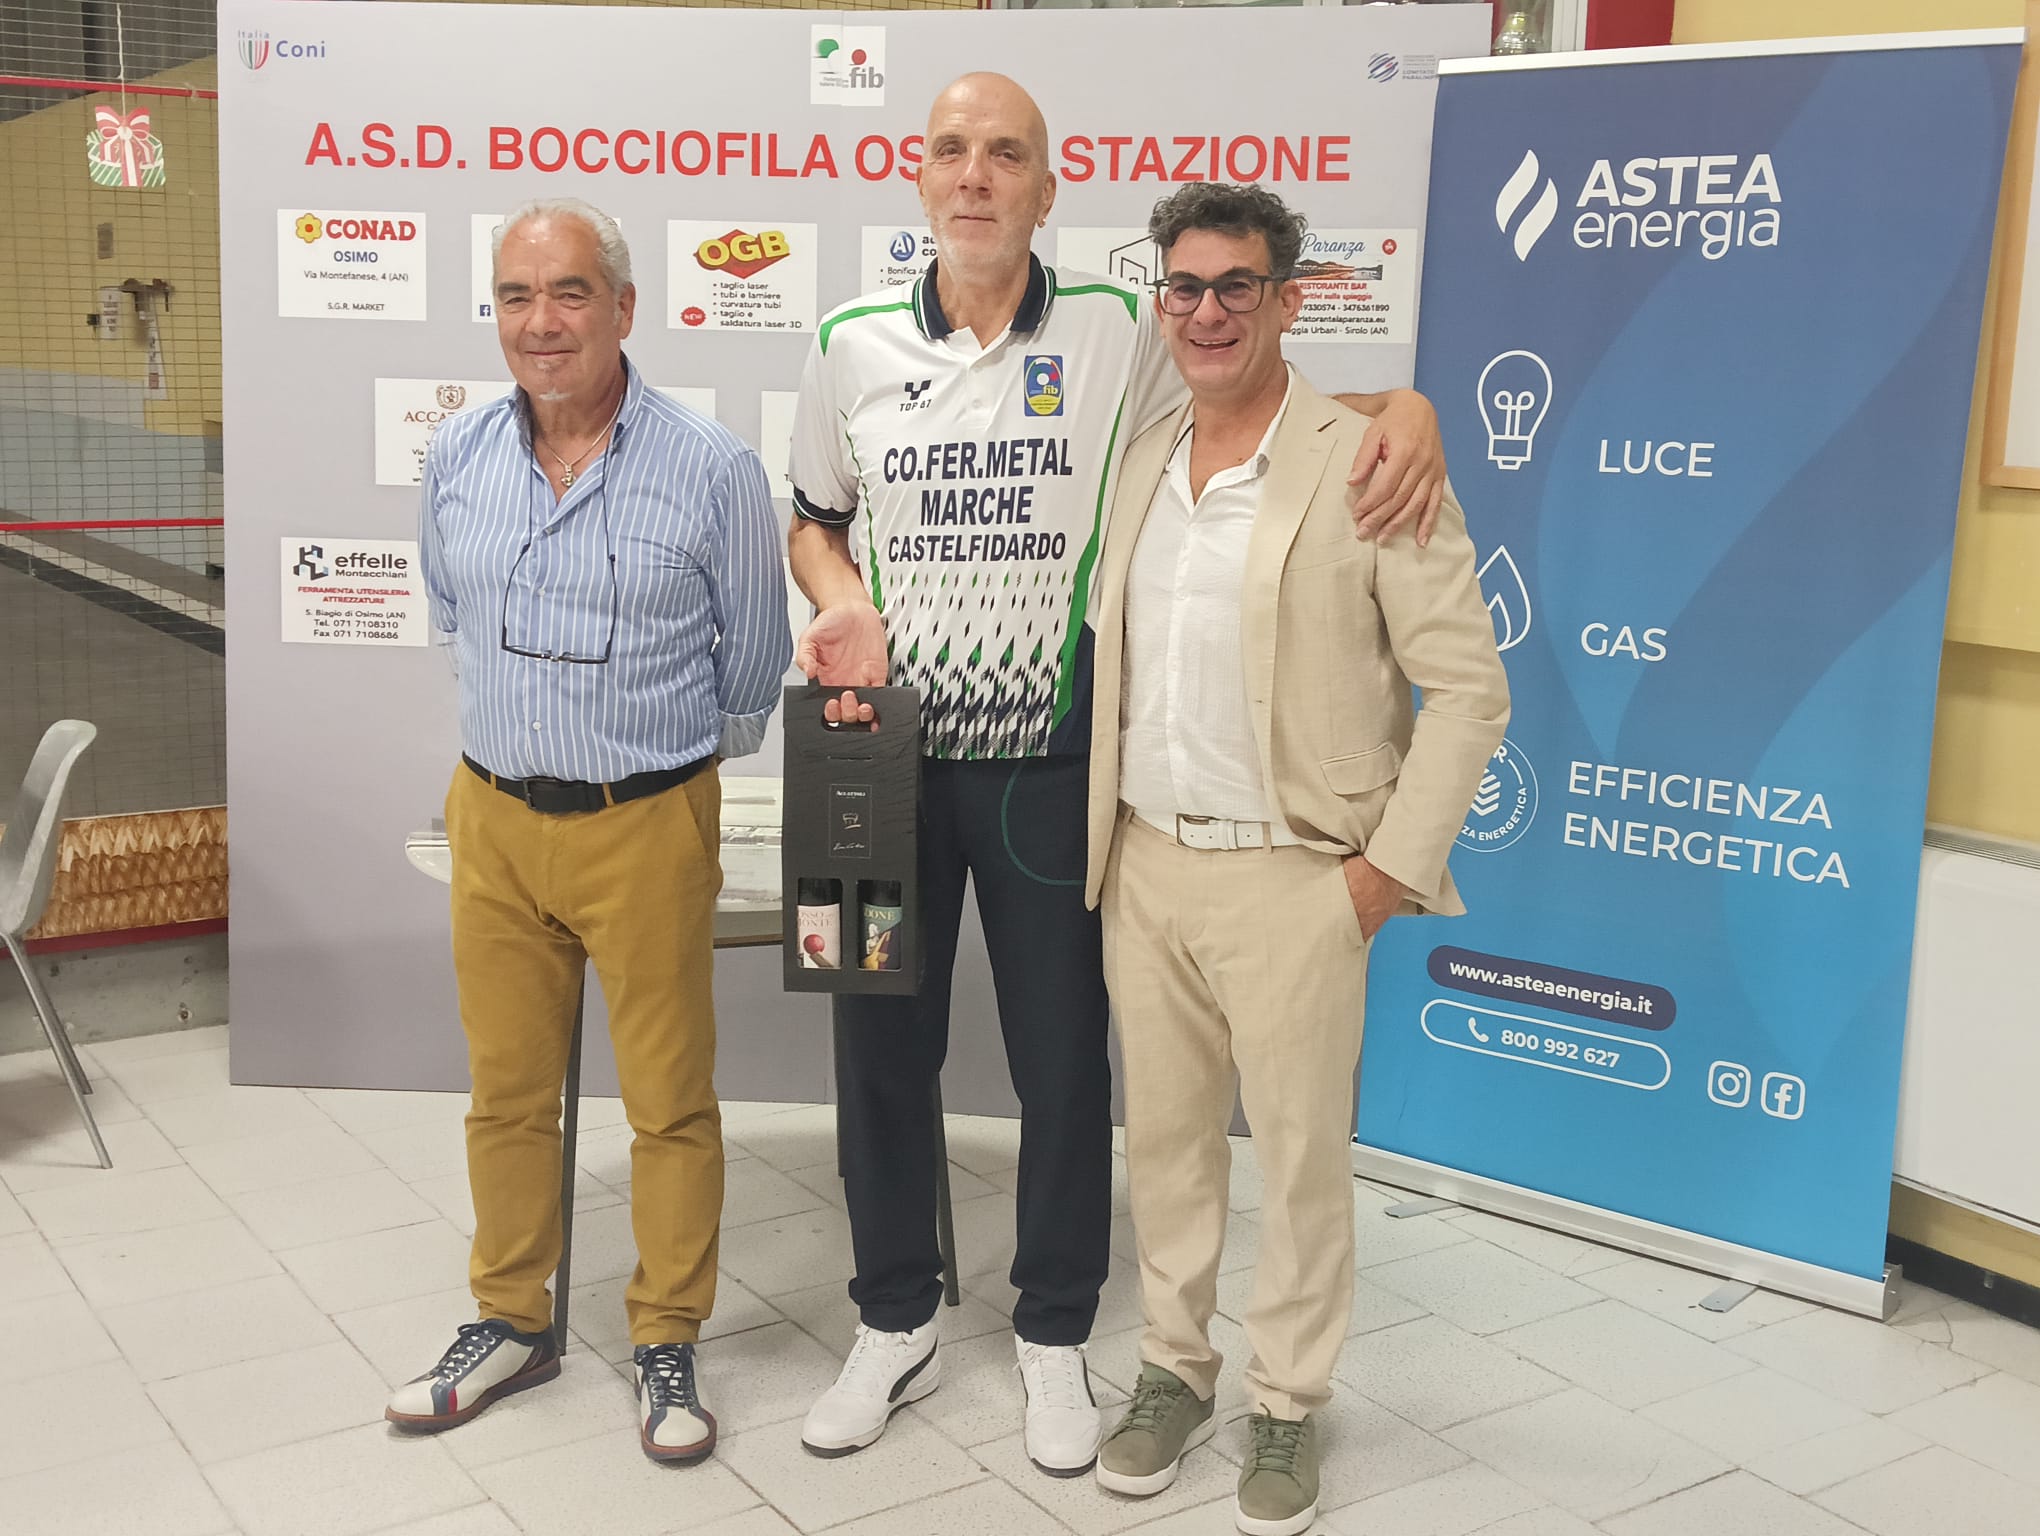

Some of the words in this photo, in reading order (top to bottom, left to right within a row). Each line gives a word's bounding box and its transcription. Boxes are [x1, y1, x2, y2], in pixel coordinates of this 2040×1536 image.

[276, 40, 325, 58] Coni
[849, 66, 884, 88] fib
[305, 122, 467, 170] A.S.D.
[489, 126, 838, 178] BOCCIOFILA
[1060, 136, 1351, 182] STAZIONE
[1576, 153, 1782, 208] ASTEA
[326, 219, 416, 241] CONAD
[1573, 208, 1781, 260] energia
[696, 230, 791, 267] OGB
[1299, 233, 1366, 260] Paranza
[333, 250, 378, 263] OSIMO
[304, 270, 317, 279] Via
[389, 273, 409, 282] (AN)
[887, 266, 917, 275] Bonifica
[720, 282, 745, 291] taglio
[747, 282, 769, 290] laser
[1351, 282, 1367, 290] BAR
[720, 291, 738, 299] tubi
[748, 292, 781, 300] lamiere
[352, 303, 385, 311] MARKET
[720, 301, 762, 309] curvatura
[764, 301, 782, 309] tubi
[720, 310, 745, 319] taglio
[720, 320, 762, 328] saldatura
[789, 321, 802, 329] 3D
[1311, 326, 1338, 334] Urbani
[1345, 326, 1369, 334] Sirolo
[1370, 326, 1389, 335] (AN)
[1042, 385, 1058, 395] fib
[899, 402, 918, 412] TOP
[412, 448, 425, 456] Via
[1598, 439, 1716, 477] LUCE
[883, 437, 1073, 484] CO.FER.METAL
[920, 485, 1034, 527] MARCHE
[888, 531, 1066, 563] CASTELFIDARDO
[335, 552, 408, 569] effelle
[335, 569, 408, 578] Montecchiani
[298, 586, 354, 594] FERRAMENTA
[356, 588, 411, 596] UTENSILERIA
[323, 596, 385, 604] ATTREZZATURE
[315, 609, 342, 618] Biagio
[345, 609, 353, 617] di
[355, 610, 384, 618] Osimo
[386, 611, 406, 619] (AN)
[313, 619, 330, 627] Tel.
[333, 619, 351, 627] 071
[356, 620, 399, 629] 7108310
[313, 629, 330, 637] Fax
[356, 631, 399, 639] 7108686
[1580, 623, 1668, 663] GAS
[1567, 760, 1833, 830] EFFICIENZA
[1562, 811, 1851, 889] ENERGETICA
[1449, 959, 1654, 1016] www.asteaenergia.it
[1500, 1028, 1539, 1051] 800
[1543, 1038, 1579, 1061] 992
[1583, 1046, 1621, 1070] 627
